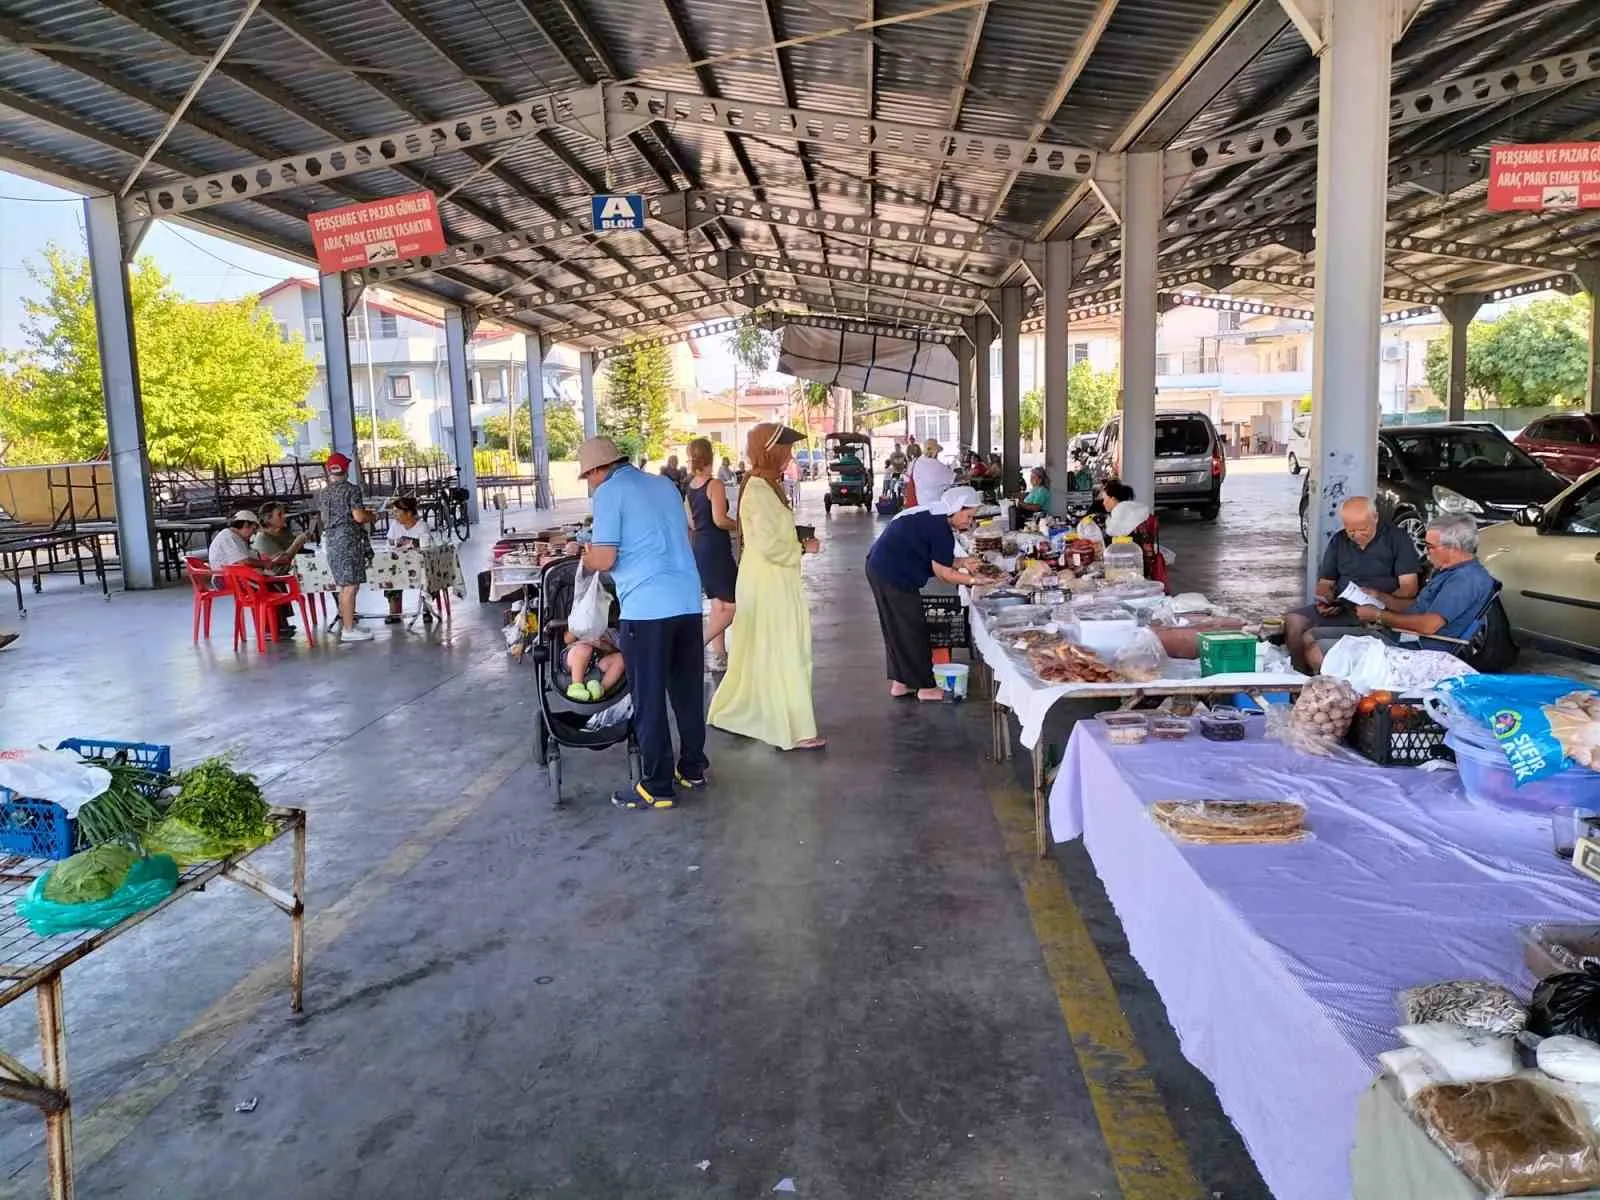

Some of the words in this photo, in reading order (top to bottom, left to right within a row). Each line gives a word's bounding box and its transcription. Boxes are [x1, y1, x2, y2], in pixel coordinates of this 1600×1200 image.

[1496, 150, 1544, 168] PERŞEMBE
[1545, 149, 1558, 163] VE
[1559, 148, 1589, 163] PAZAR
[1497, 172, 1521, 190] ARAÇ
[1523, 172, 1548, 186] PARK
[1549, 171, 1580, 185] ETMEK
[1582, 169, 1600, 184] YAS
[314, 213, 359, 232] PERŞEMBE
[358, 209, 369, 224] VE
[369, 204, 397, 221] PAZAR
[396, 194, 431, 215] GÜNLERİ
[600, 197, 636, 218] A
[323, 235, 345, 252] ARAÇ
[345, 230, 366, 246] PARK
[366, 226, 394, 242] ETMEK
[394, 218, 432, 237] YASAKTIR
[602, 219, 635, 229] BLOK
[1501, 743, 1533, 781] ATIK
[1513, 734, 1546, 772] SIFIR
